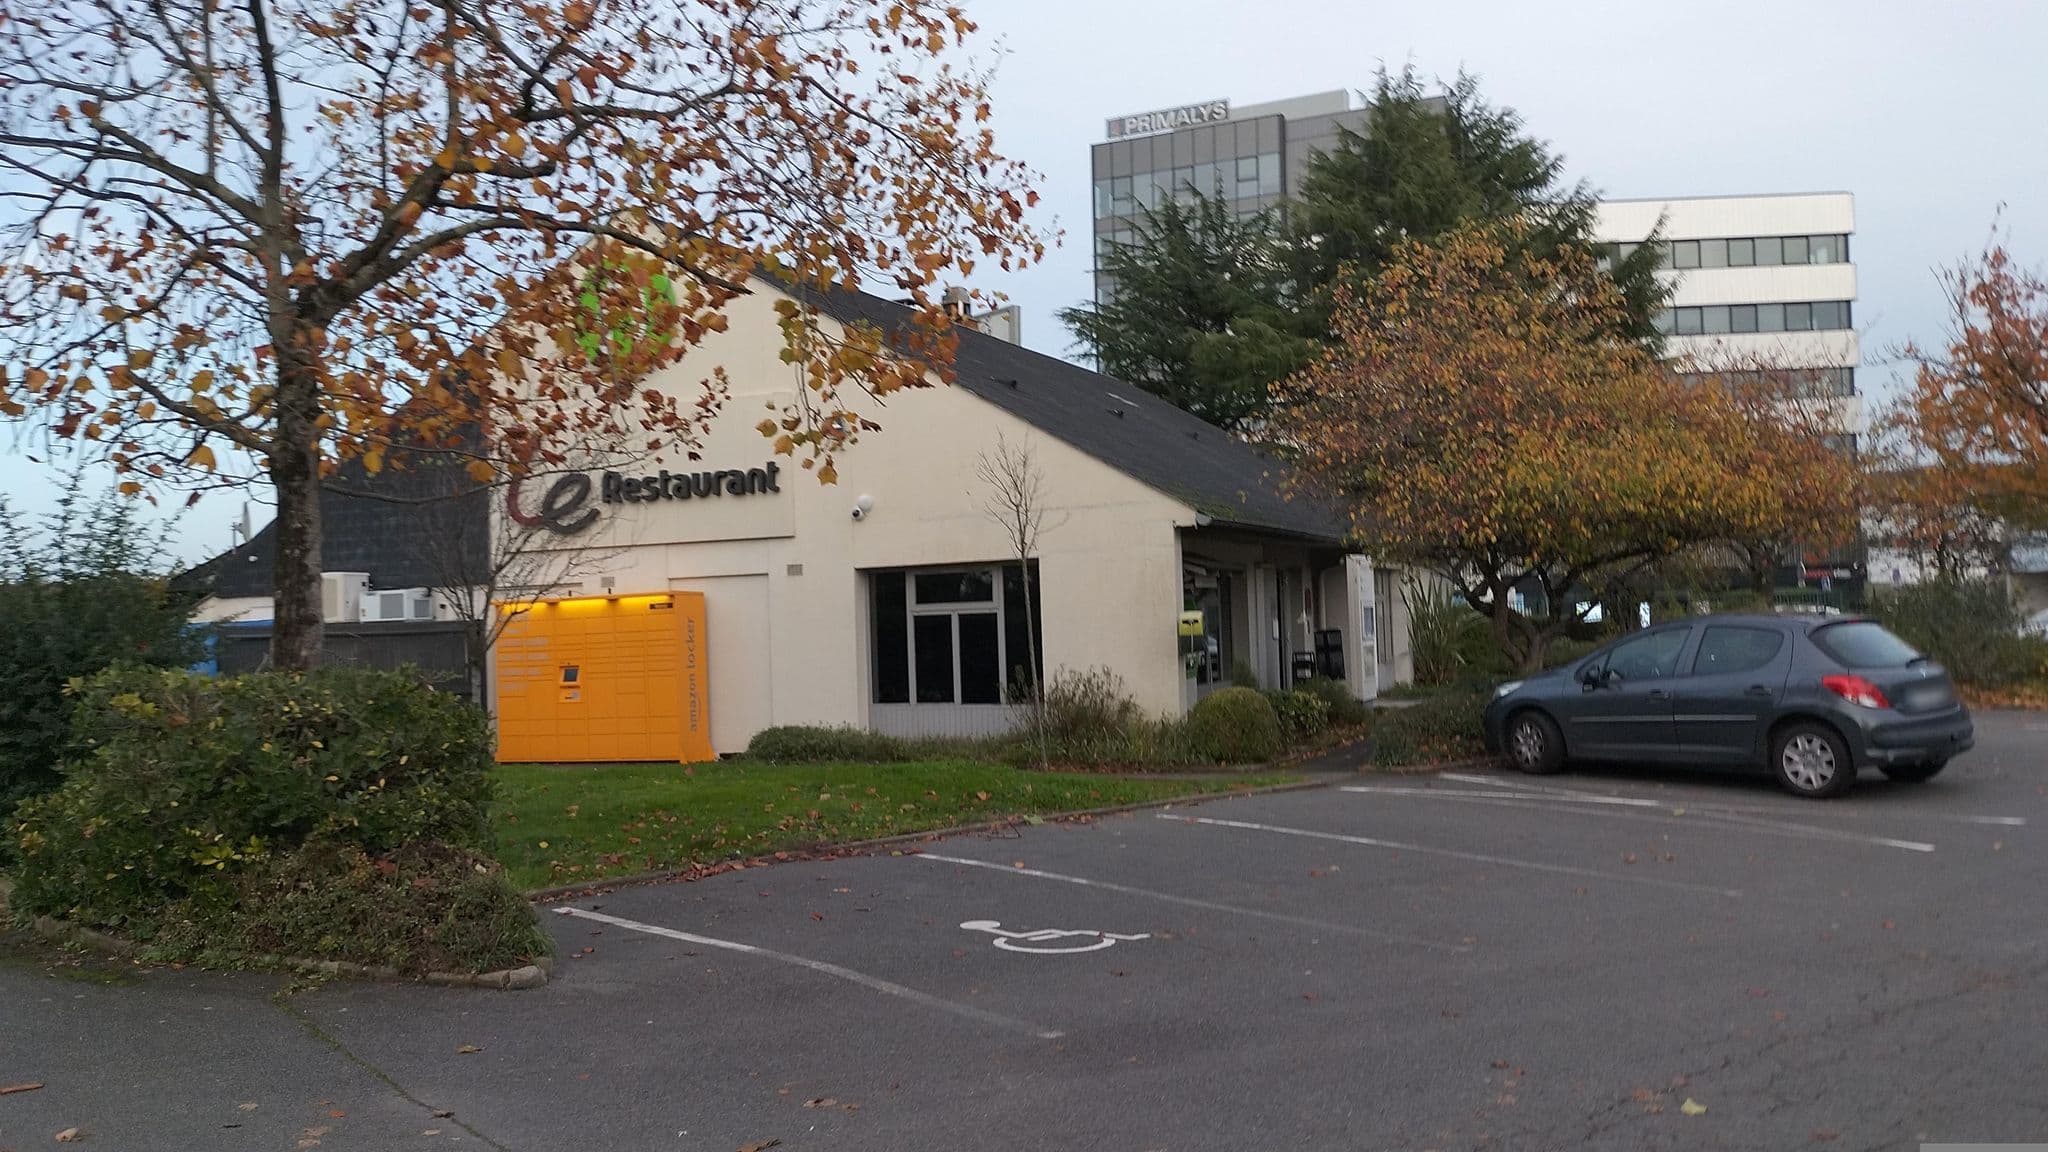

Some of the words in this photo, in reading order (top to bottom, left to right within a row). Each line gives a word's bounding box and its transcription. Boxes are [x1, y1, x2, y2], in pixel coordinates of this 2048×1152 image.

[1125, 101, 1227, 135] PRIMALYS
[602, 461, 780, 503] Restaurant
[686, 616, 696, 669] locker
[689, 673, 697, 732] amazon
